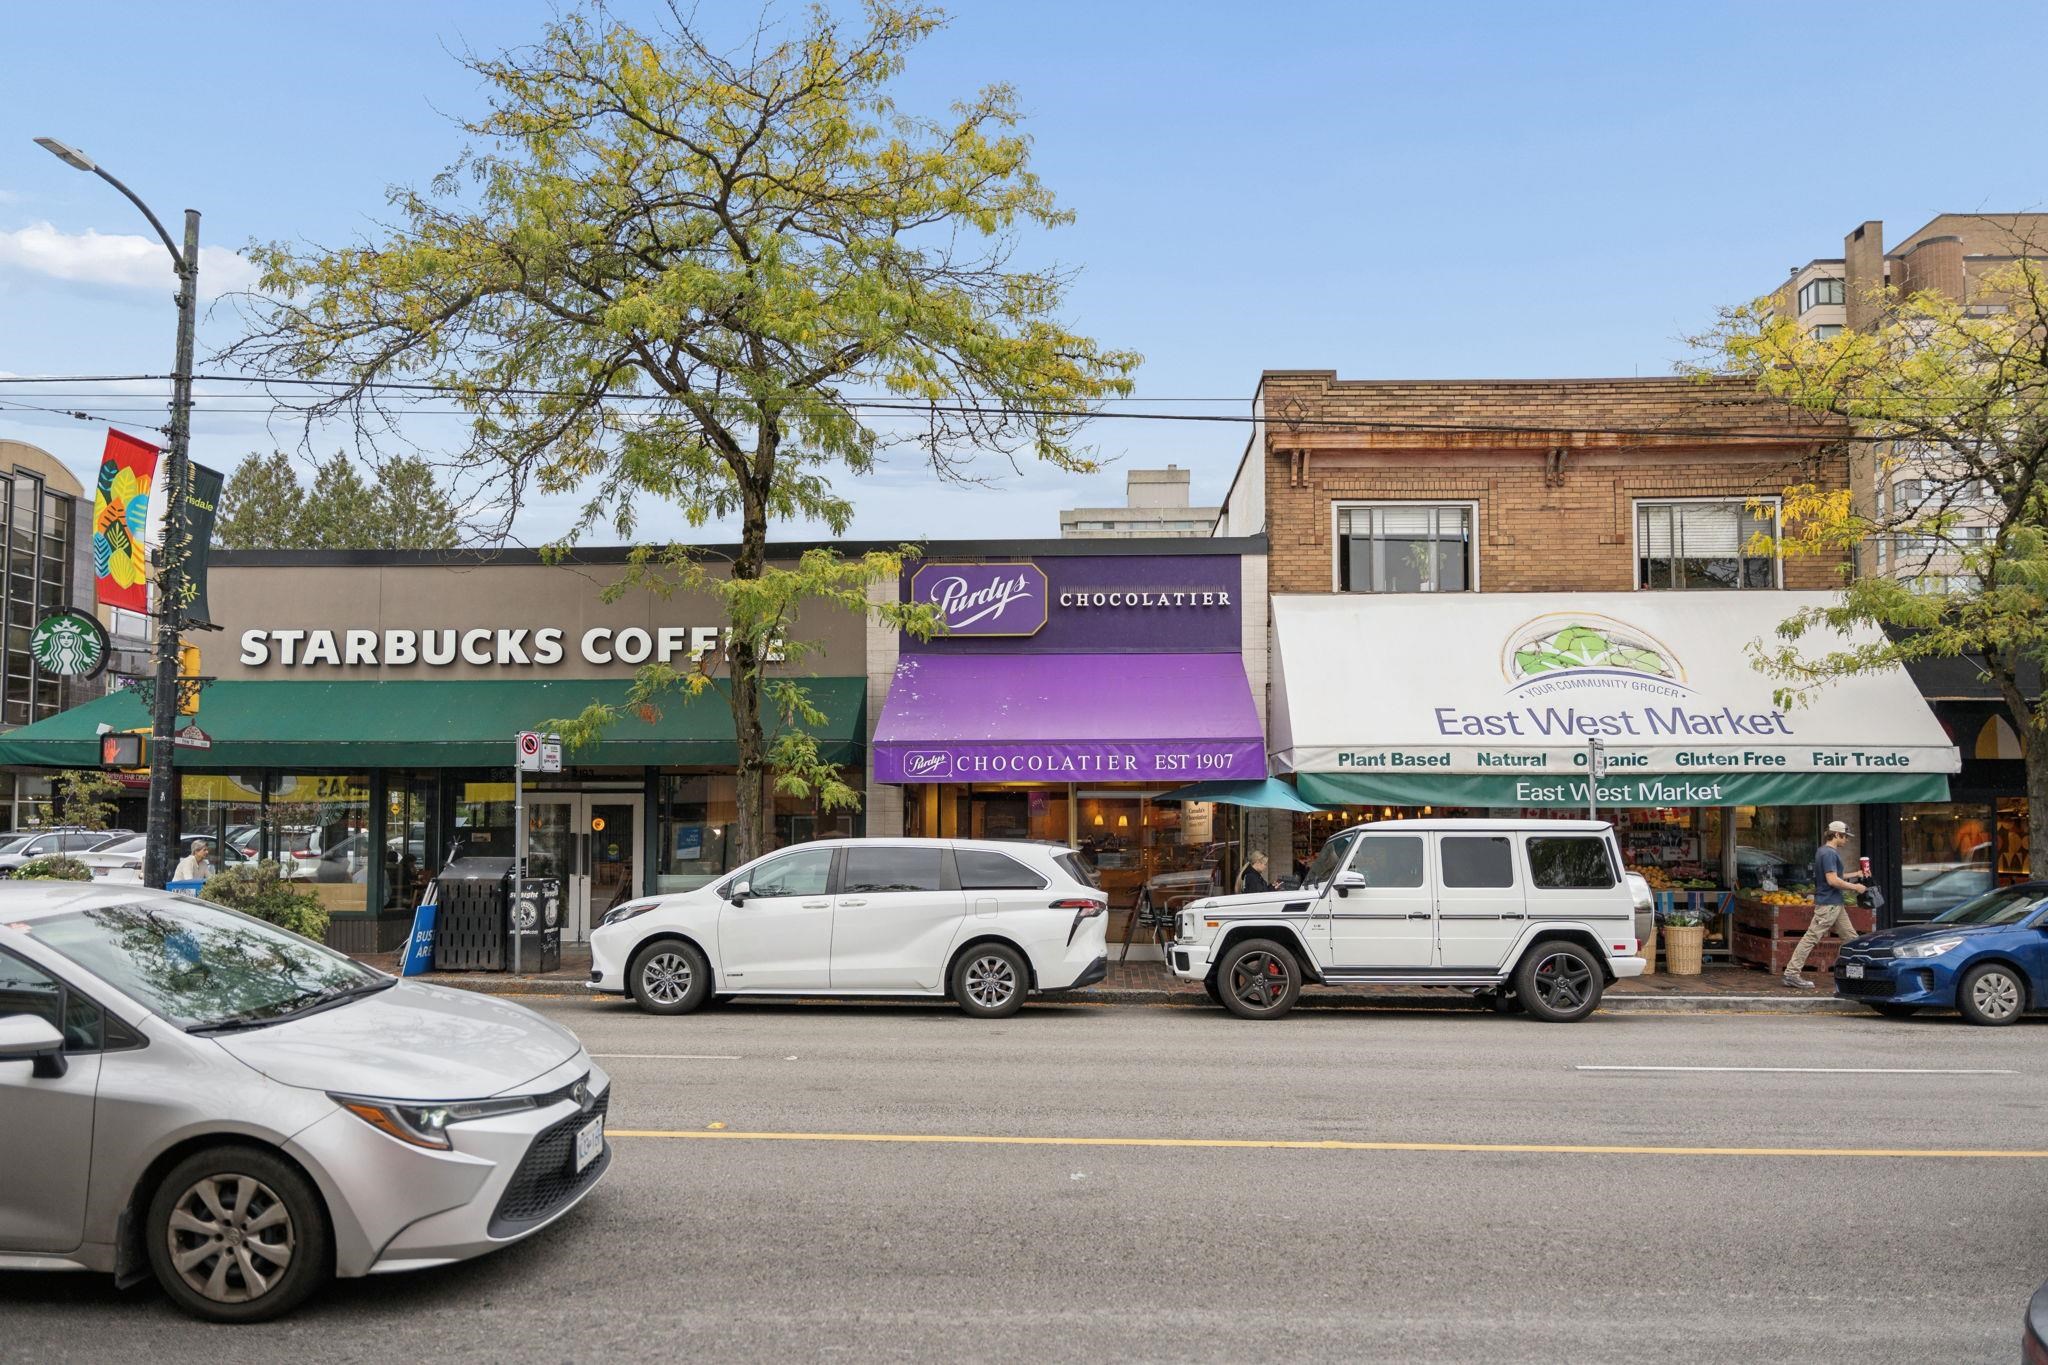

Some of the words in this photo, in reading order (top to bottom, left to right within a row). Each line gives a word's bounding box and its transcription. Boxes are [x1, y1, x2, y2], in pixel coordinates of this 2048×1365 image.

[185, 494, 214, 512] risdale
[930, 573, 1033, 628] Purdys
[1060, 592, 1232, 607] CHOCOLATIER
[239, 627, 565, 666] STARBUCKS
[580, 626, 785, 665] COFFE
[1525, 683, 1556, 698] YOUR
[1556, 678, 1628, 692] COMMUNITY
[1631, 681, 1679, 699] GROCER
[1434, 707, 1524, 736] East
[1526, 707, 1641, 736] West
[1644, 706, 1794, 736] Market
[908, 753, 948, 773] Purdys
[956, 755, 1139, 772] CHOCOLATIER
[1154, 754, 1189, 770] EST
[1196, 753, 1234, 770] 1907
[1338, 752, 1386, 767] Plant
[1391, 752, 1451, 767] Based
[1477, 752, 1547, 767] Natural
[1573, 752, 1649, 770] Oanic
[1675, 752, 1739, 766] Gluten
[1743, 752, 1786, 766] Free
[1812, 752, 1848, 766] Fair
[1851, 752, 1910, 767] Trade
[1516, 782, 1566, 801] East
[1569, 782, 1632, 801] West
[1638, 781, 1724, 801] Market
